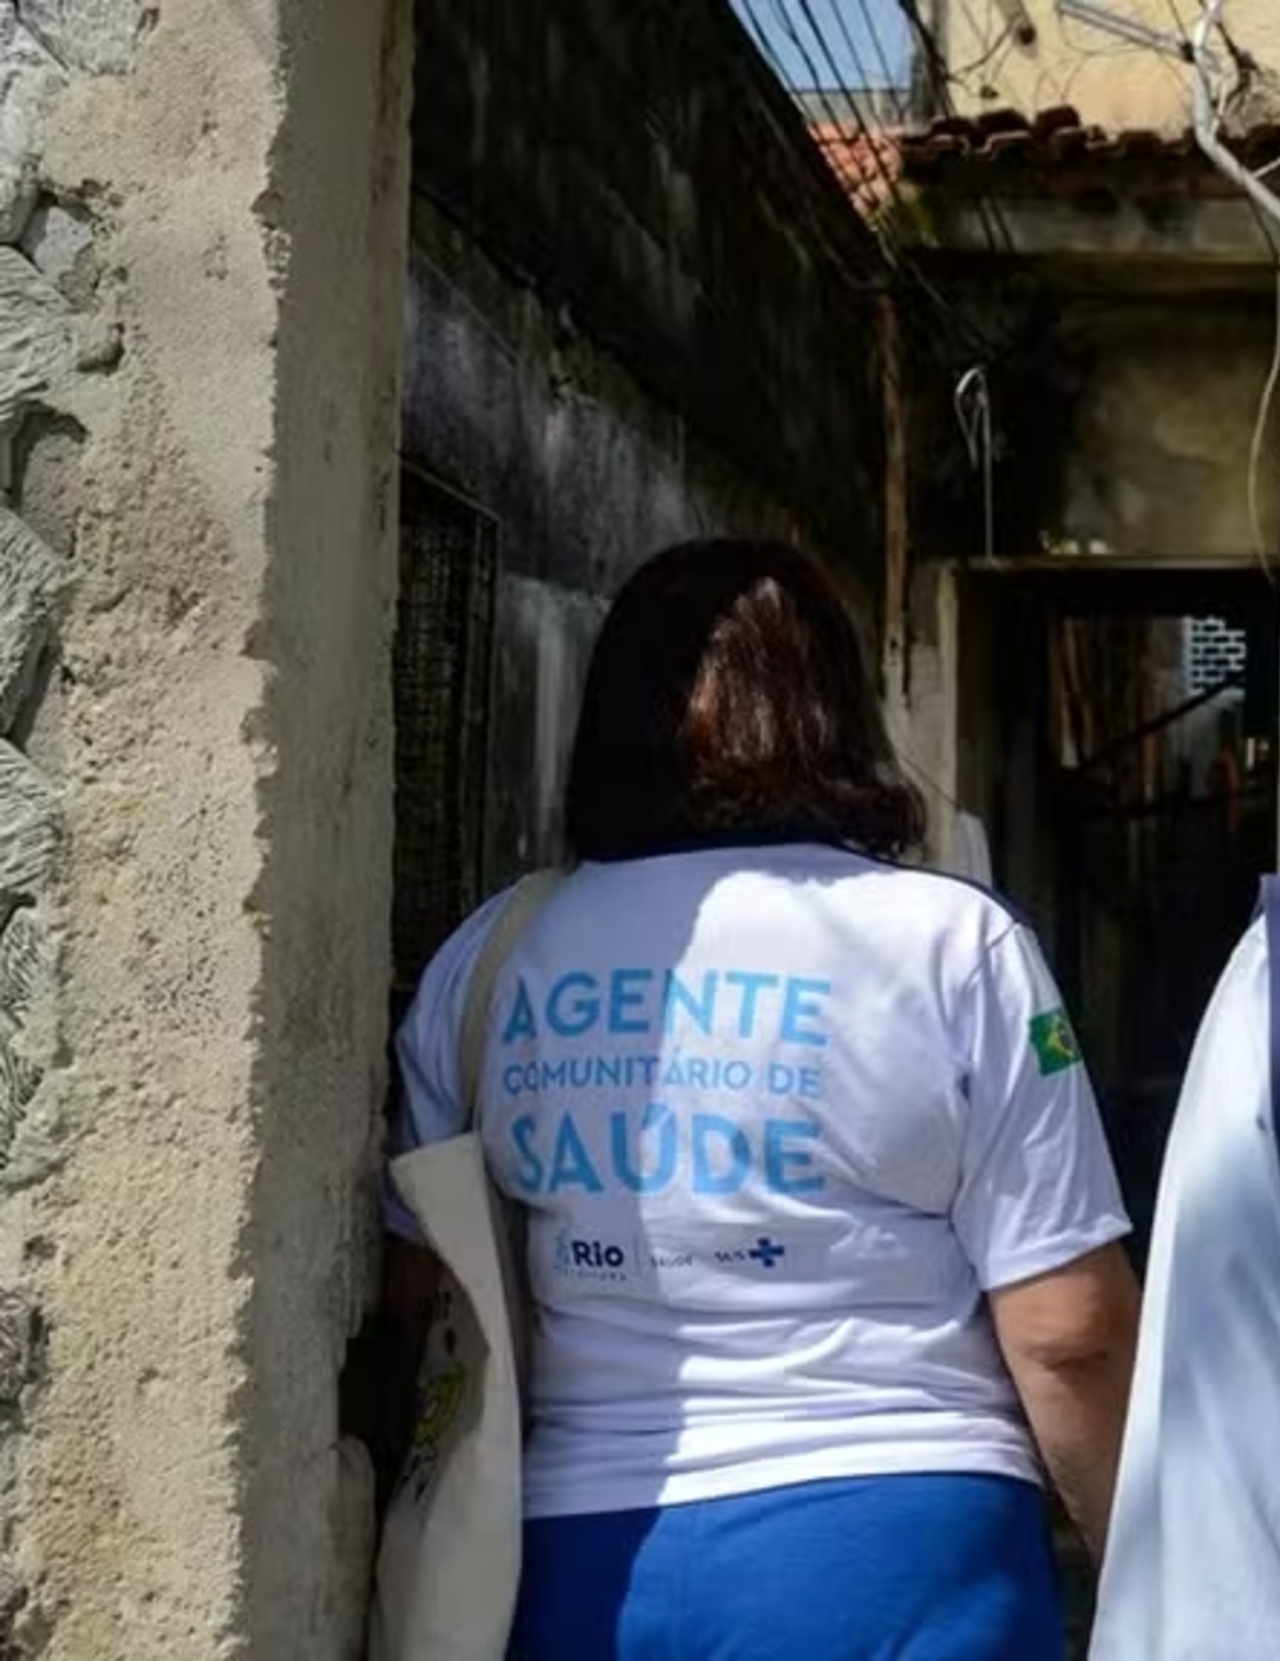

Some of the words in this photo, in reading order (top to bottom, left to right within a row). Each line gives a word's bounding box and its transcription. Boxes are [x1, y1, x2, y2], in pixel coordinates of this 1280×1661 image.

[503, 968, 831, 1046] AGENTE
[503, 1050, 752, 1097] COMUNITÁRIO
[769, 1058, 821, 1096] DE
[510, 1103, 828, 1197] SAÚDE
[571, 1240, 625, 1268] Rio
